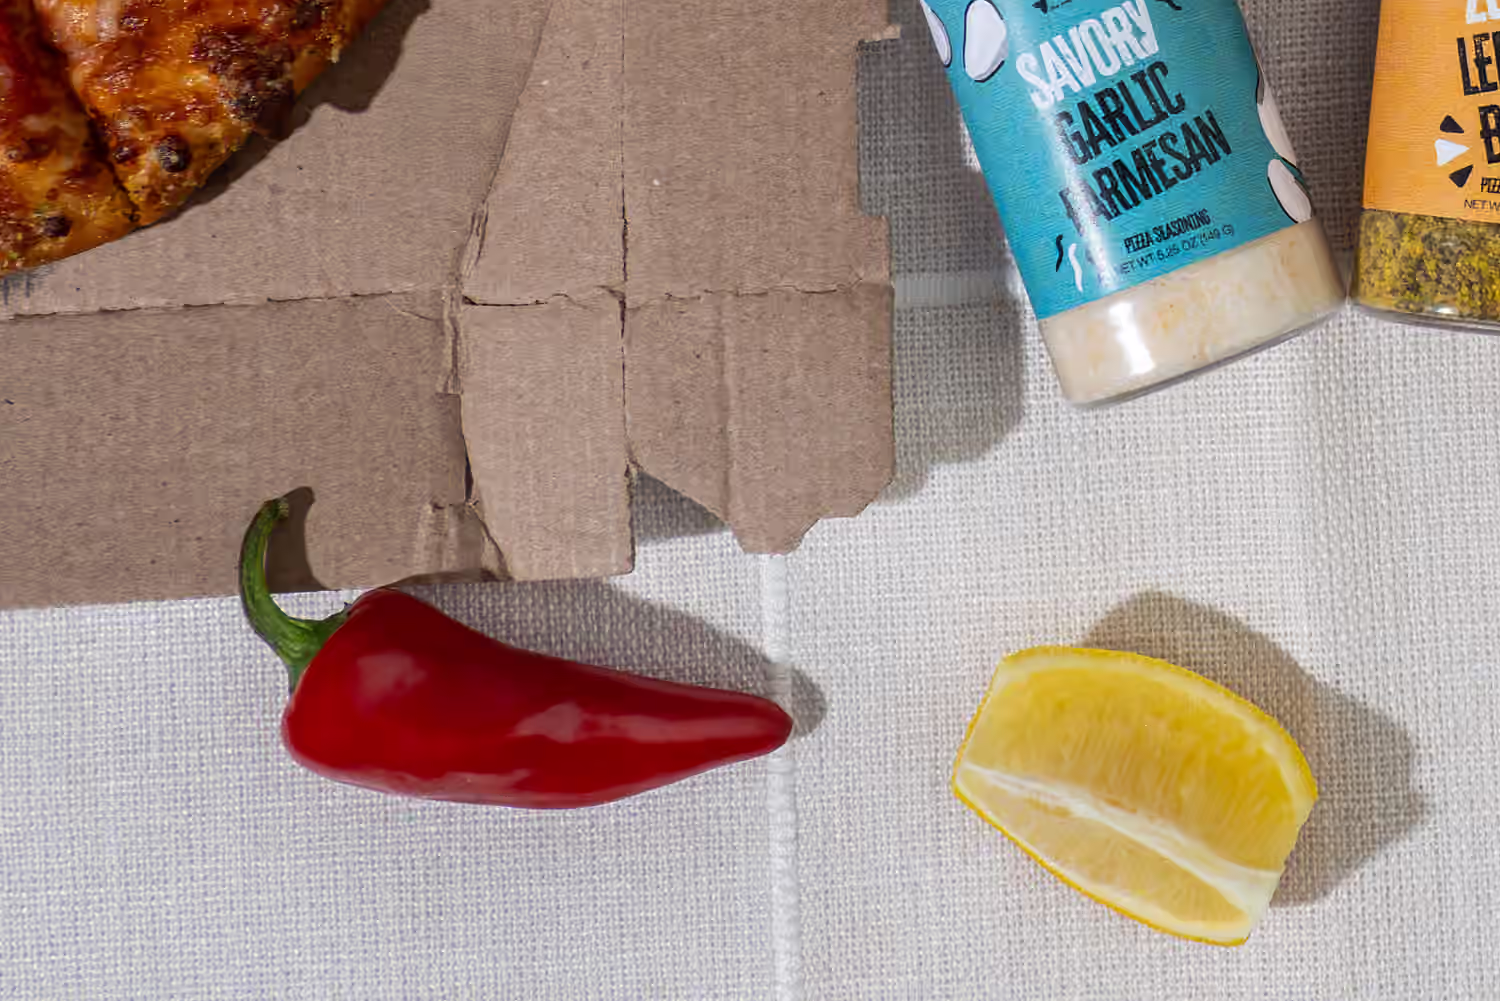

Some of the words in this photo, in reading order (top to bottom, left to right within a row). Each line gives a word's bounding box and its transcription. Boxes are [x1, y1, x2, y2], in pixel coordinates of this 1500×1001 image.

[1055, 61, 1186, 166] GARLIC
[1463, 199, 1488, 210] NET
[1123, 231, 1154, 255] PIZZA
[1152, 207, 1212, 243] SEASONING
[1182, 236, 1199, 252] OZ
